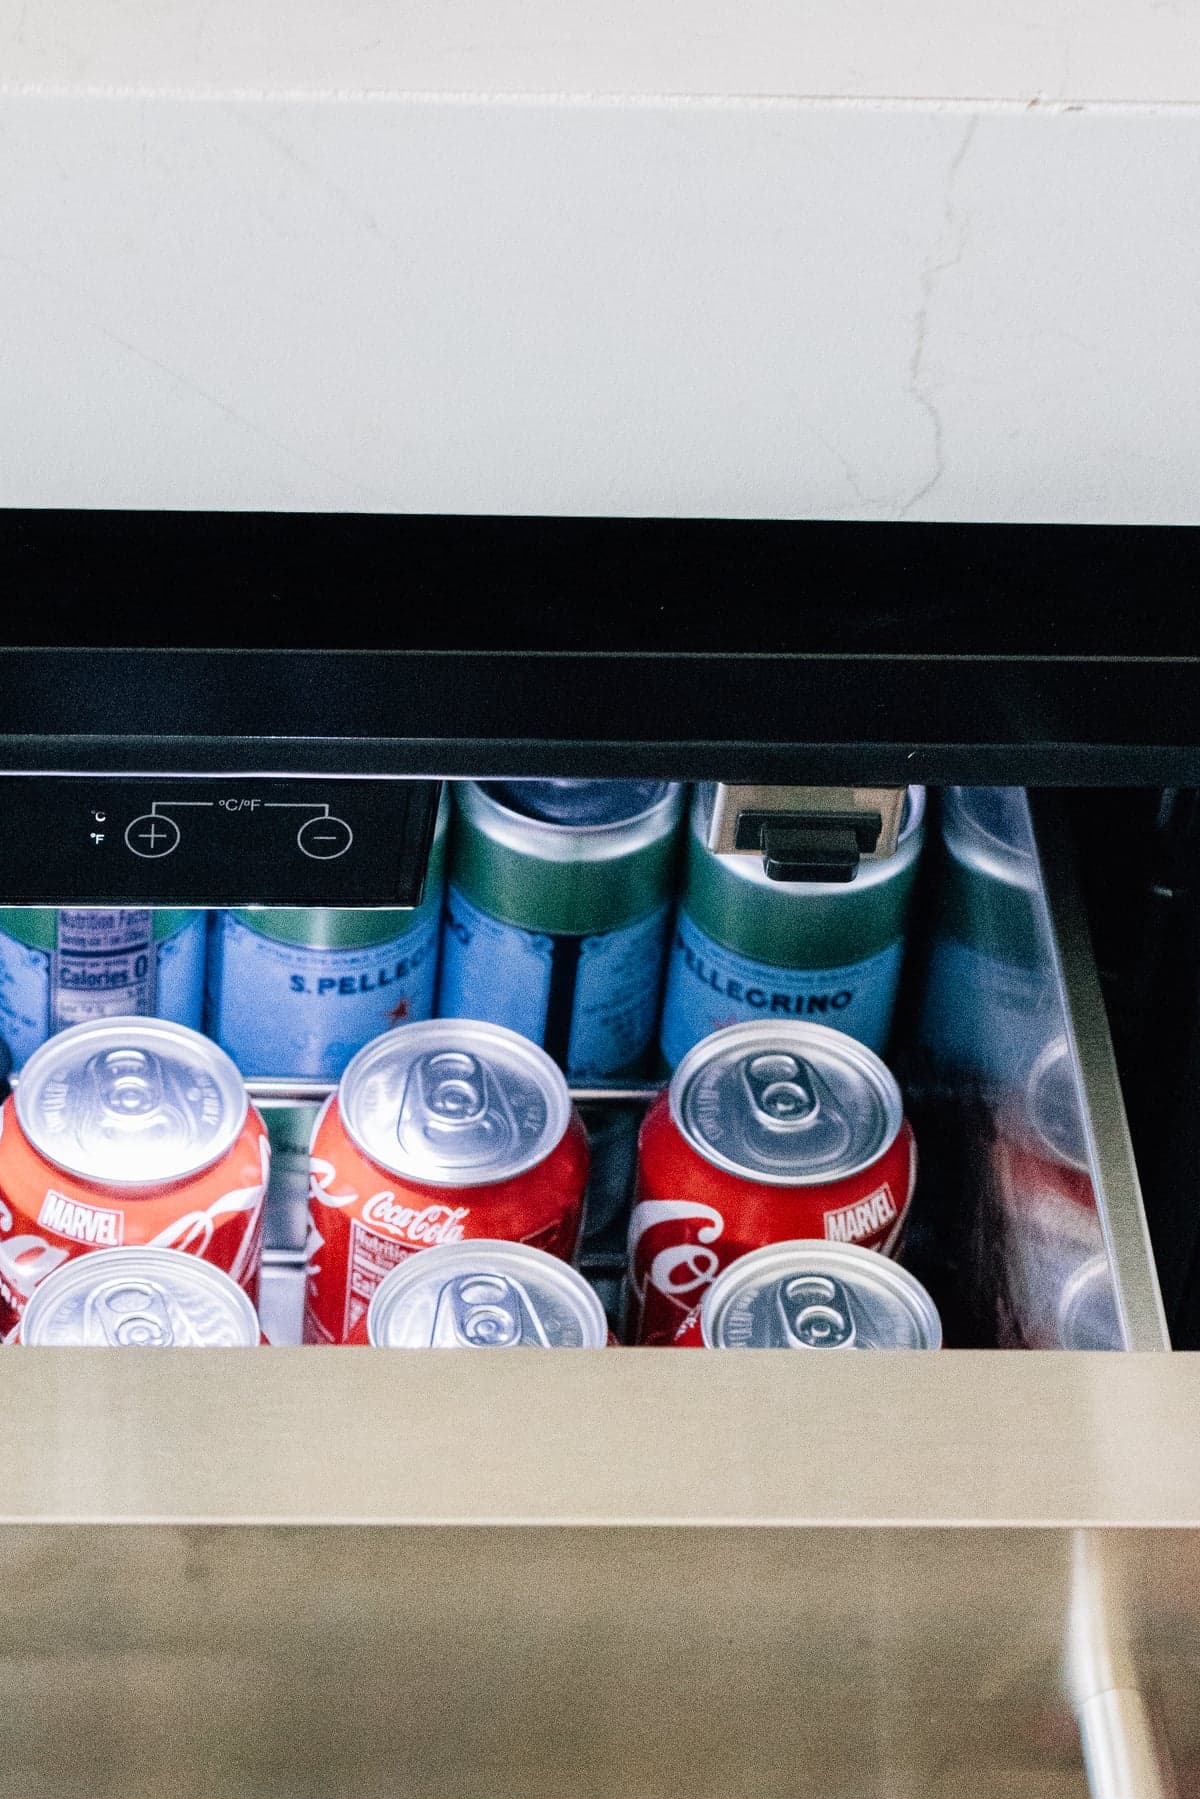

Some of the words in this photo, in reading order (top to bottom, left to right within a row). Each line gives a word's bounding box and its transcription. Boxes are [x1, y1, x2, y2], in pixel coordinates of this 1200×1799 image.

[218, 798, 262, 812] °C/°F
[89, 832, 106, 845] °F
[60, 966, 129, 987] Calories
[133, 953, 149, 980] 0
[41, 1191, 120, 1247] MARVEL
[826, 1189, 896, 1242] MARVEL
